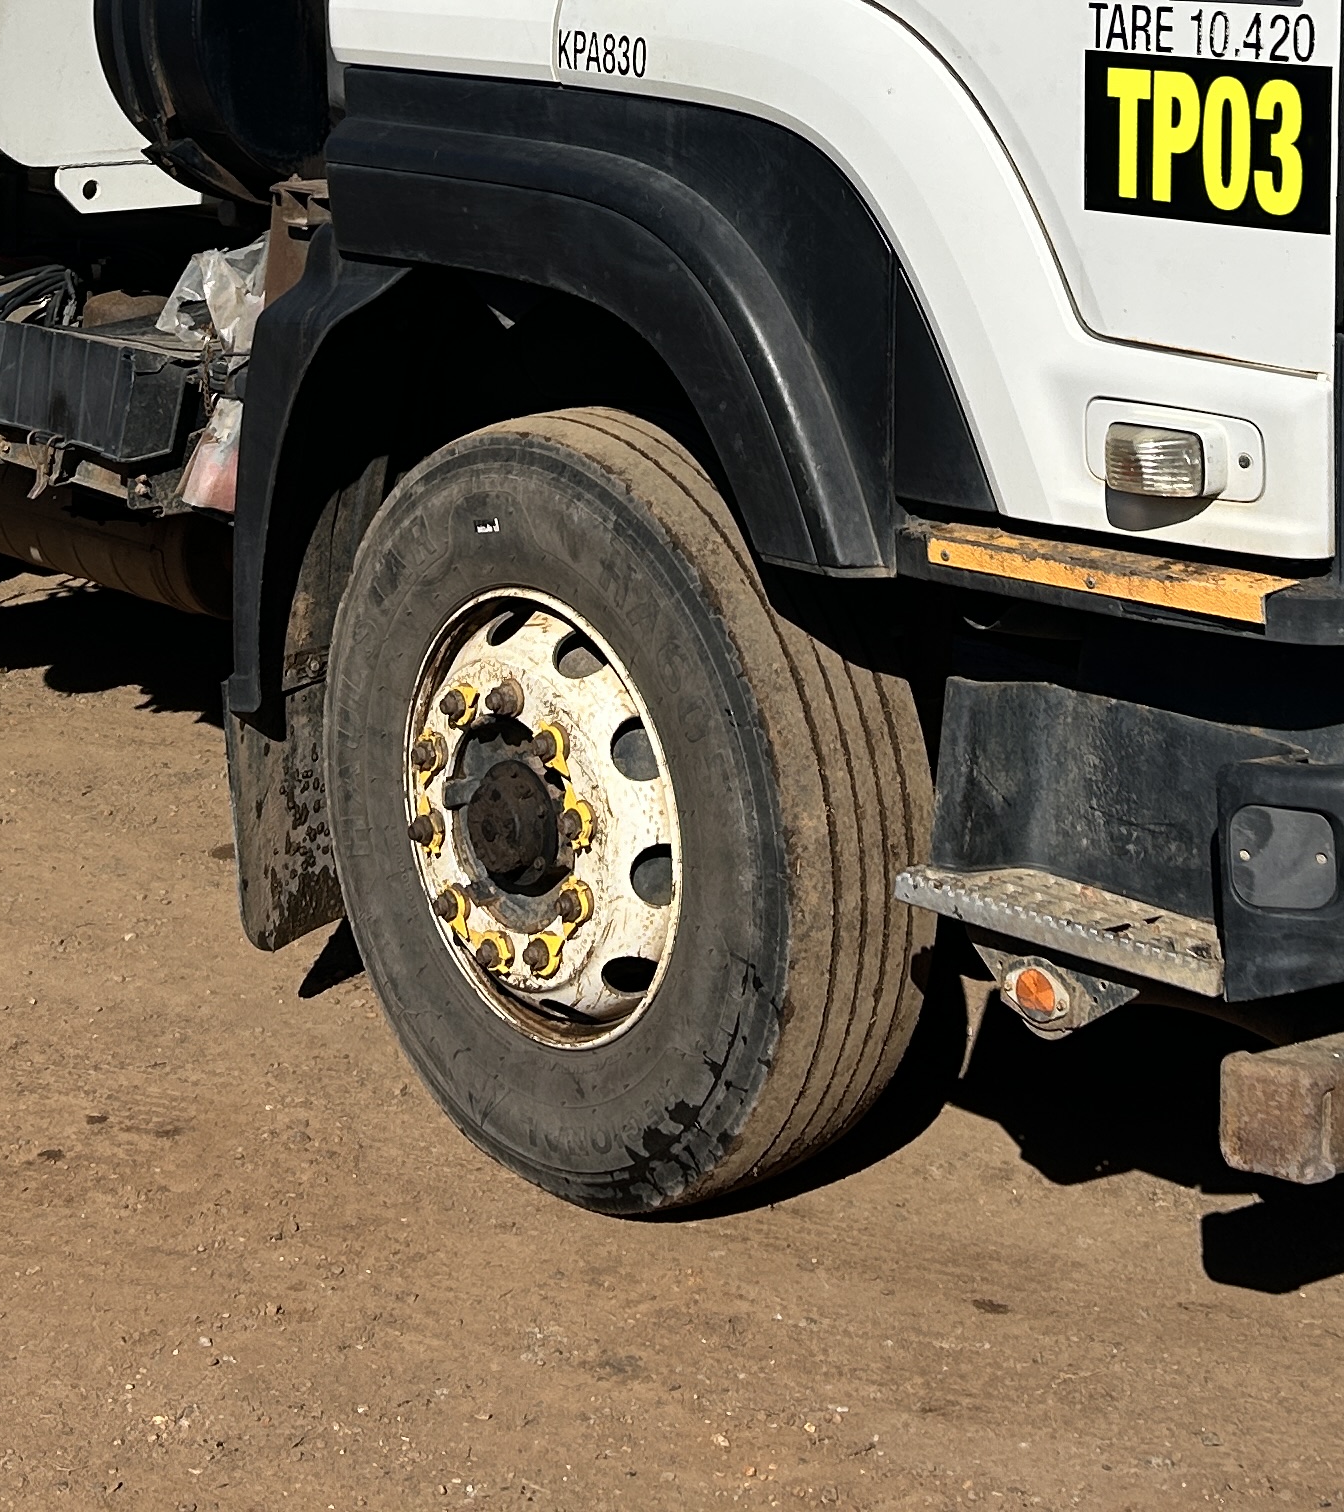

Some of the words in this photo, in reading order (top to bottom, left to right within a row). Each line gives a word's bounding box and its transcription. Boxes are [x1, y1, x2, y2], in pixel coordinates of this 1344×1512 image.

[558, 29, 647, 78] KPA830
[1088, 2, 1174, 53] TARE
[1191, 8, 1316, 63] 10.420
[1107, 67, 1303, 216] TP03
